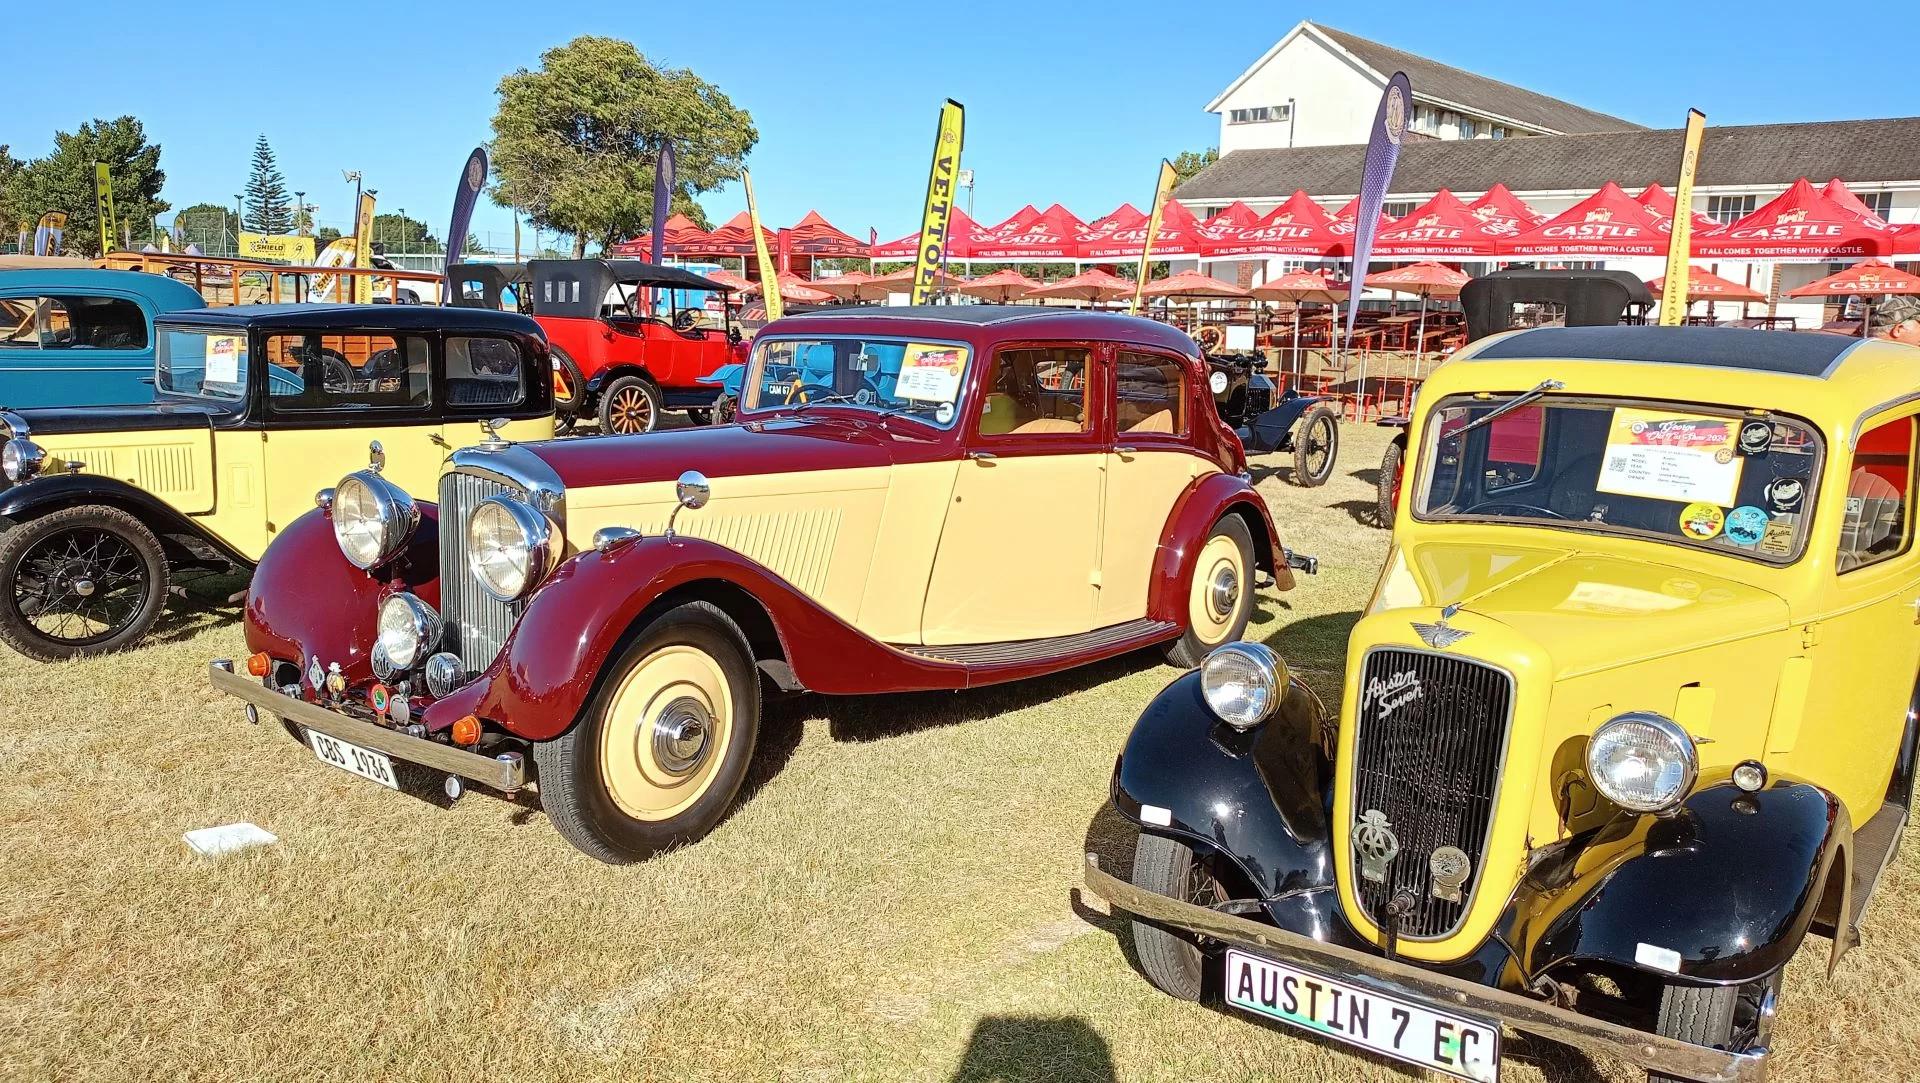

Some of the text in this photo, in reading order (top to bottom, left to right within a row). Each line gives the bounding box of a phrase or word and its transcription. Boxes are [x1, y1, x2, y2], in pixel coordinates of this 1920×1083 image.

[1113, 230, 1181, 241] CASLE
[1238, 226, 1314, 239] CASTLE
[1379, 228, 1463, 240] CASTLE
[1543, 224, 1640, 237] CASTLE
[1731, 225, 1843, 238] CASTLE
[999, 234, 1061, 244] CASTLE
[1754, 247, 1798, 255] TOGETHER
[1830, 246, 1864, 254] CASTLE.
[1829, 281, 1908, 289] CASTLE
[769, 385, 782, 395] CAM
[1659, 421, 1696, 433] George
[1364, 670, 1420, 711] Austin
[1379, 683, 1424, 720] Seven
[316, 735, 389, 782] CBS 1936
[1237, 962, 1480, 1076] AUSTIN 7 EC
